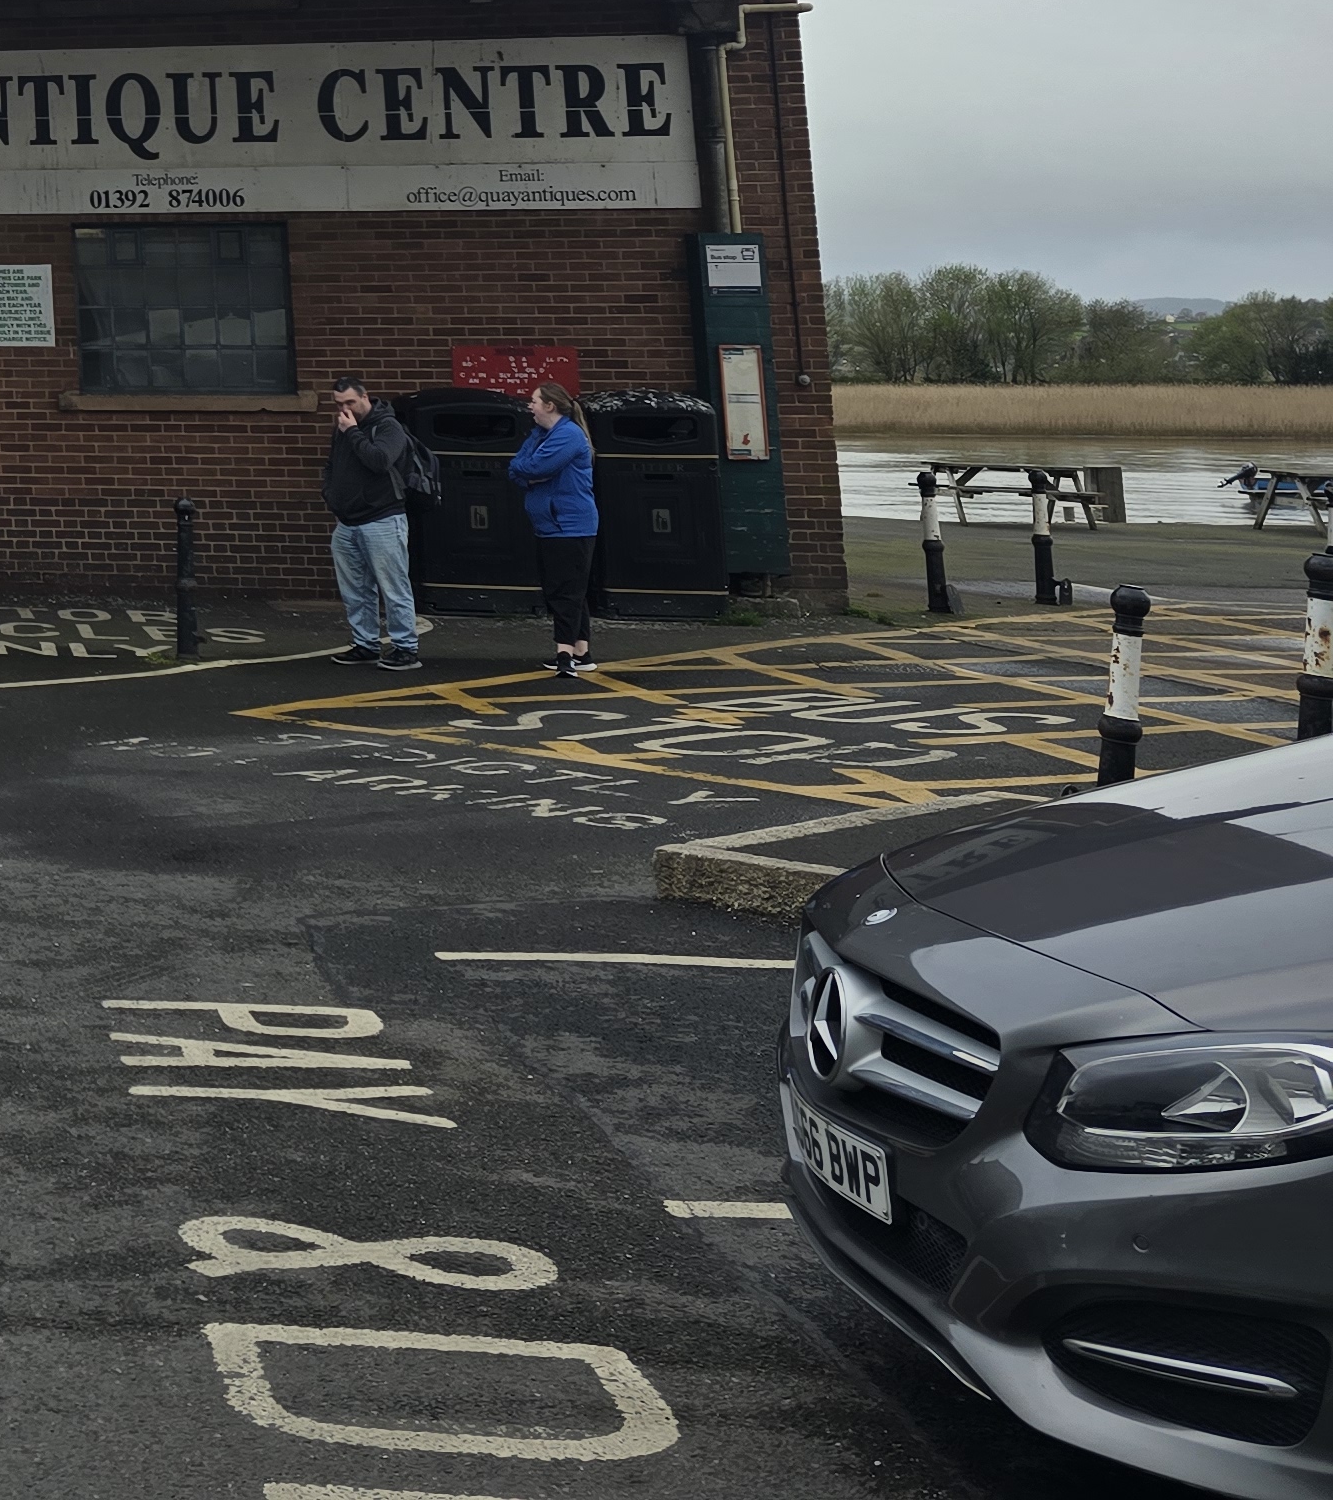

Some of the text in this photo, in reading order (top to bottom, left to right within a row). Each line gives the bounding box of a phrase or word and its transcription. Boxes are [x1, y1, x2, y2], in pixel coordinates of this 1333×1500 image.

[316, 62, 673, 143] CENTRE
[132, 173, 199, 189] Telephone:
[406, 185, 637, 207] office@quayantiques.com
[499, 168, 545, 182] Email:
[89, 187, 246, 209] 01392 874006
[688, 692, 1076, 734] BUS
[447, 709, 959, 767] STOP
[824, 1128, 882, 1205] BWP
[101, 999, 680, 1499] PAY & D
